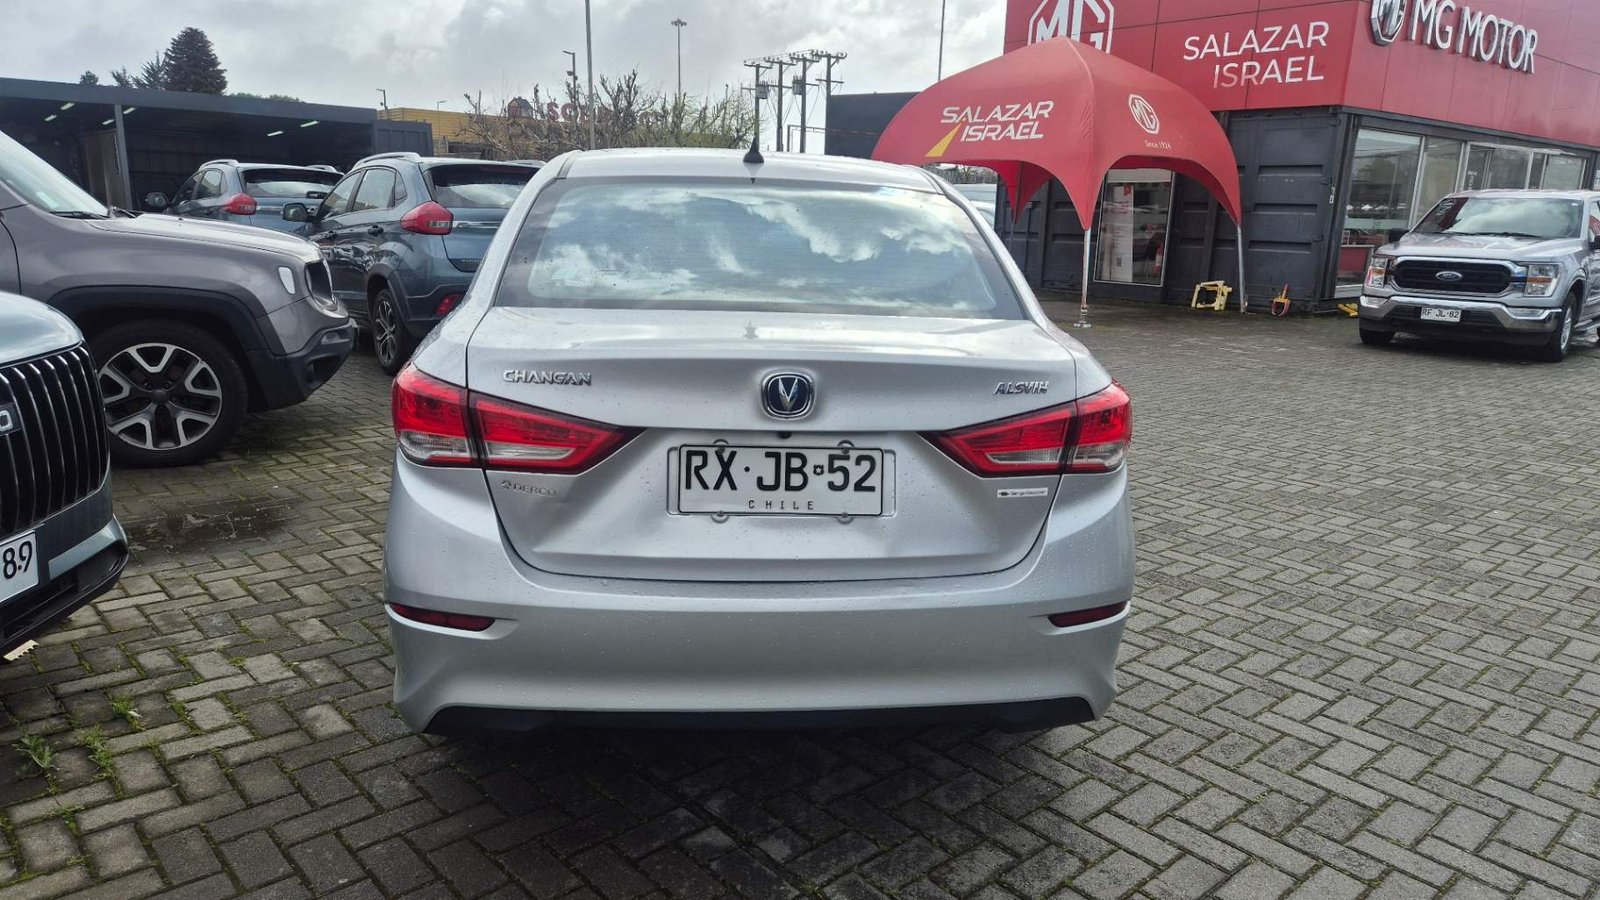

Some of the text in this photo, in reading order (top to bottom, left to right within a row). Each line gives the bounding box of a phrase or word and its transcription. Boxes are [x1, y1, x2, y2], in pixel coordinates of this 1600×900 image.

[1183, 21, 1330, 61] SALAZAR
[1410, 0, 1538, 74] MG MOTOR
[1213, 55, 1324, 88] ISRAEL
[941, 101, 1054, 123] SALAZAR
[1131, 97, 1158, 131] MG
[960, 121, 1044, 142] ISRAEL
[503, 369, 592, 386] CHANGAN
[994, 381, 1050, 395] ALSVIN
[513, 482, 557, 497] DERCO
[748, 499, 815, 511] CHILE
